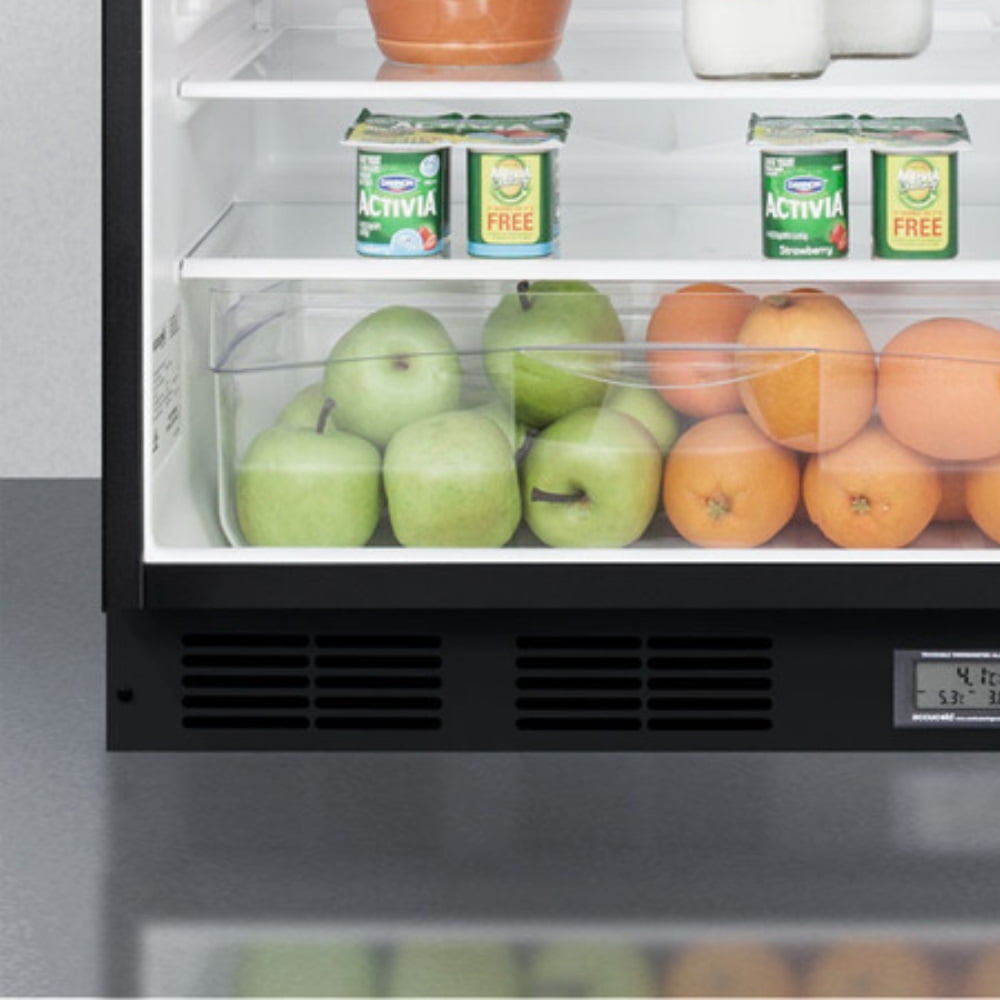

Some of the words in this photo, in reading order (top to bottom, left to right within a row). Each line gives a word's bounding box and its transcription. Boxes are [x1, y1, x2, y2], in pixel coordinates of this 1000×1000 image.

[359, 189, 437, 218] ACTIVIA
[766, 191, 844, 219] ACTIVIA
[487, 211, 533, 232] FREE
[894, 216, 942, 237] FREE
